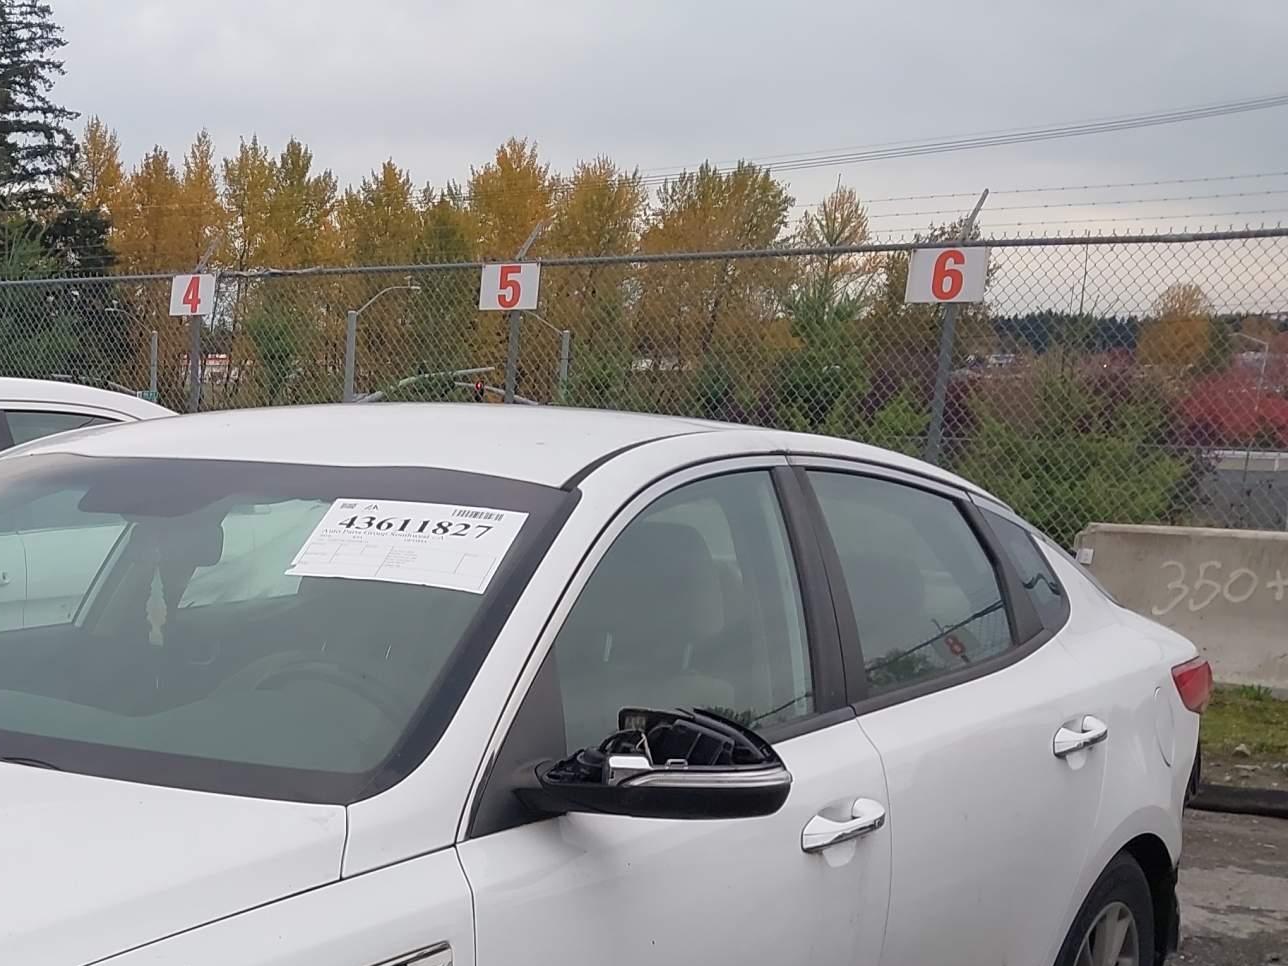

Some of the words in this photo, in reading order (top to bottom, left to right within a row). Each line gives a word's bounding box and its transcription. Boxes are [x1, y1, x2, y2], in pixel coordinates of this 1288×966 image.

[182, 276, 201, 313] 4
[496, 264, 521, 309] 5
[932, 249, 966, 300] 6
[339, 515, 494, 540] 43611827
